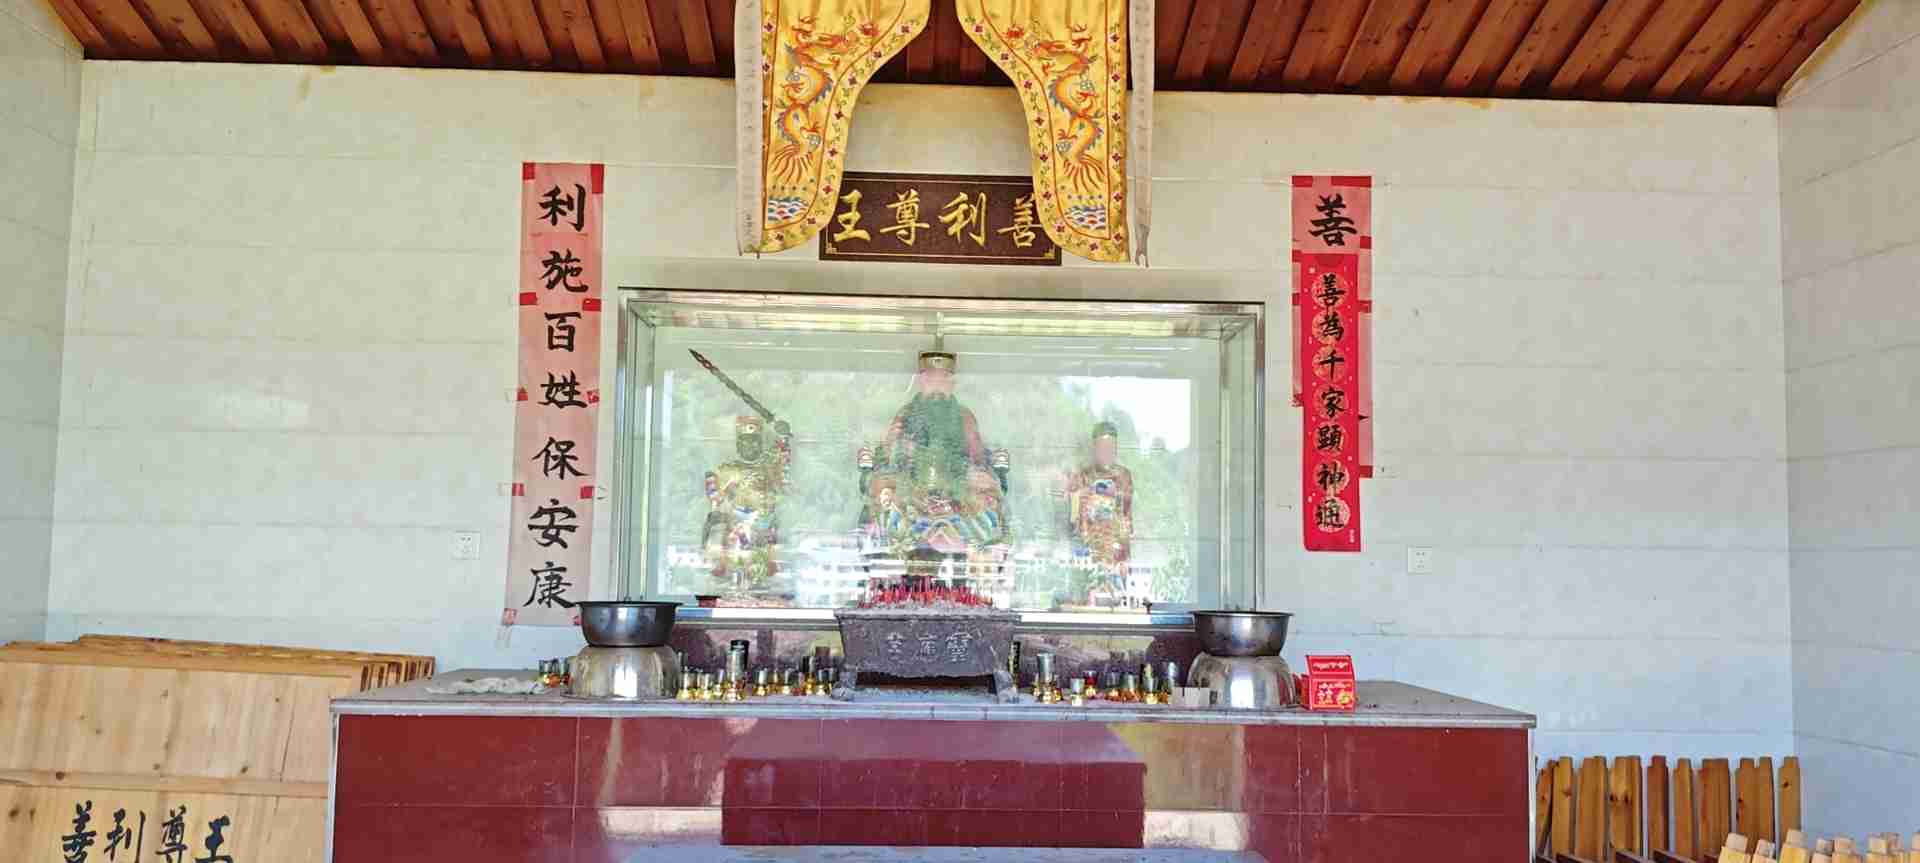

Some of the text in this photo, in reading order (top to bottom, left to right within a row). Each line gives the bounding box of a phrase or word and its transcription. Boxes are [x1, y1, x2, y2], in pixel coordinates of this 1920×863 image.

[523, 183, 591, 609] 利施百姓保安康
[61, 800, 233, 863] 善利尊王
